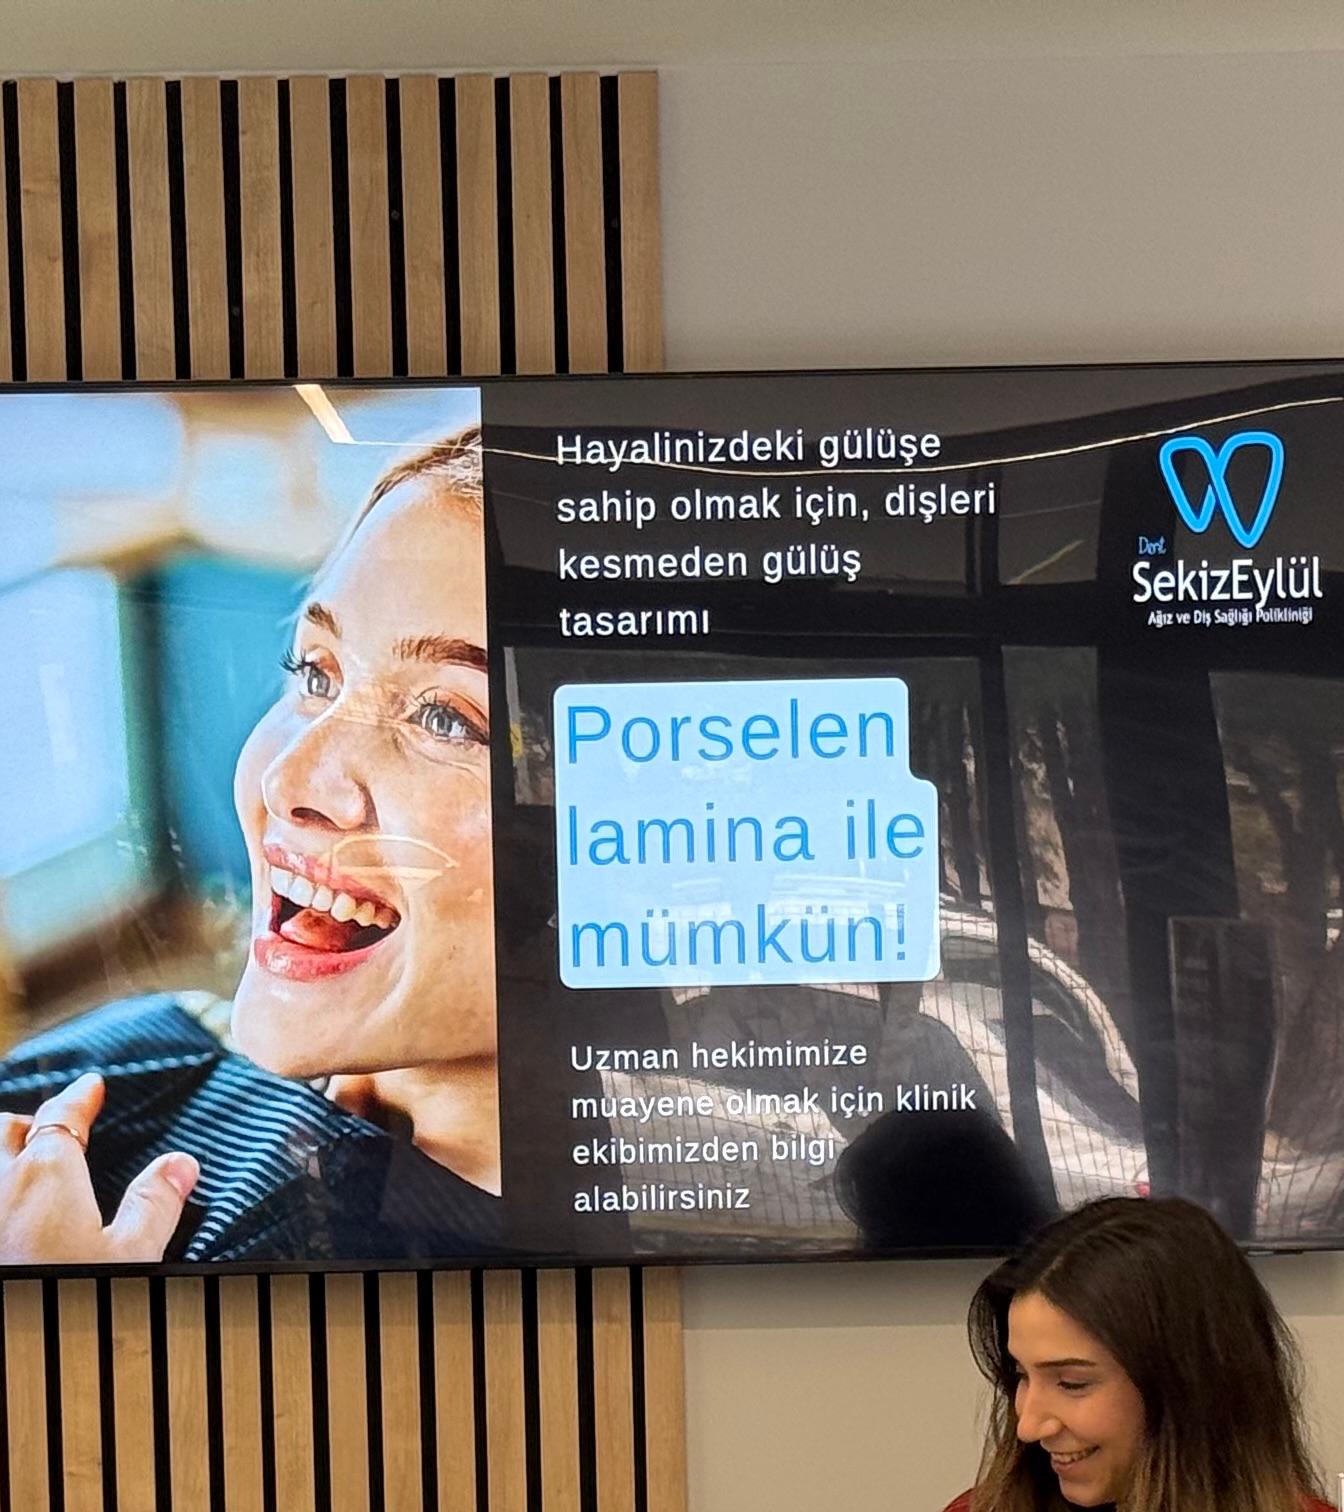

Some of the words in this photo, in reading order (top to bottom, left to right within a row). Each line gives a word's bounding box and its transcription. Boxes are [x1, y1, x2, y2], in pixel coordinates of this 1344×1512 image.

[556, 429, 805, 472] Hayalinizdeki
[819, 427, 942, 467] gülüşe
[556, 489, 656, 528] sahip
[670, 488, 782, 520] olmak
[795, 486, 870, 525] için,
[885, 482, 996, 523] dişleri
[559, 547, 748, 580] kesmeden
[763, 544, 862, 583] gülüş
[1132, 556, 1323, 609] SekizEylül
[560, 608, 710, 637] tasarımı
[1148, 610, 1173, 628] Ağız
[1176, 613, 1190, 624] ve
[1193, 610, 1211, 627] Diş
[1214, 608, 1253, 626] Sağlığı
[1256, 606, 1313, 625] Polikliniği
[567, 699, 895, 764] Porselen
[568, 802, 815, 866] lamina
[846, 799, 925, 860] ile
[571, 904, 907, 968] mümkün!
[570, 1045, 680, 1071] Uzman
[691, 1039, 868, 1069] hekimimize
[571, 1094, 715, 1124] muayene
[726, 1087, 821, 1116] olmak
[831, 1086, 884, 1119] için
[896, 1083, 977, 1112] klinik
[572, 1137, 759, 1166] ekibimizden
[771, 1134, 836, 1166] bilgi
[573, 1184, 752, 1212] alabilirsiniz
